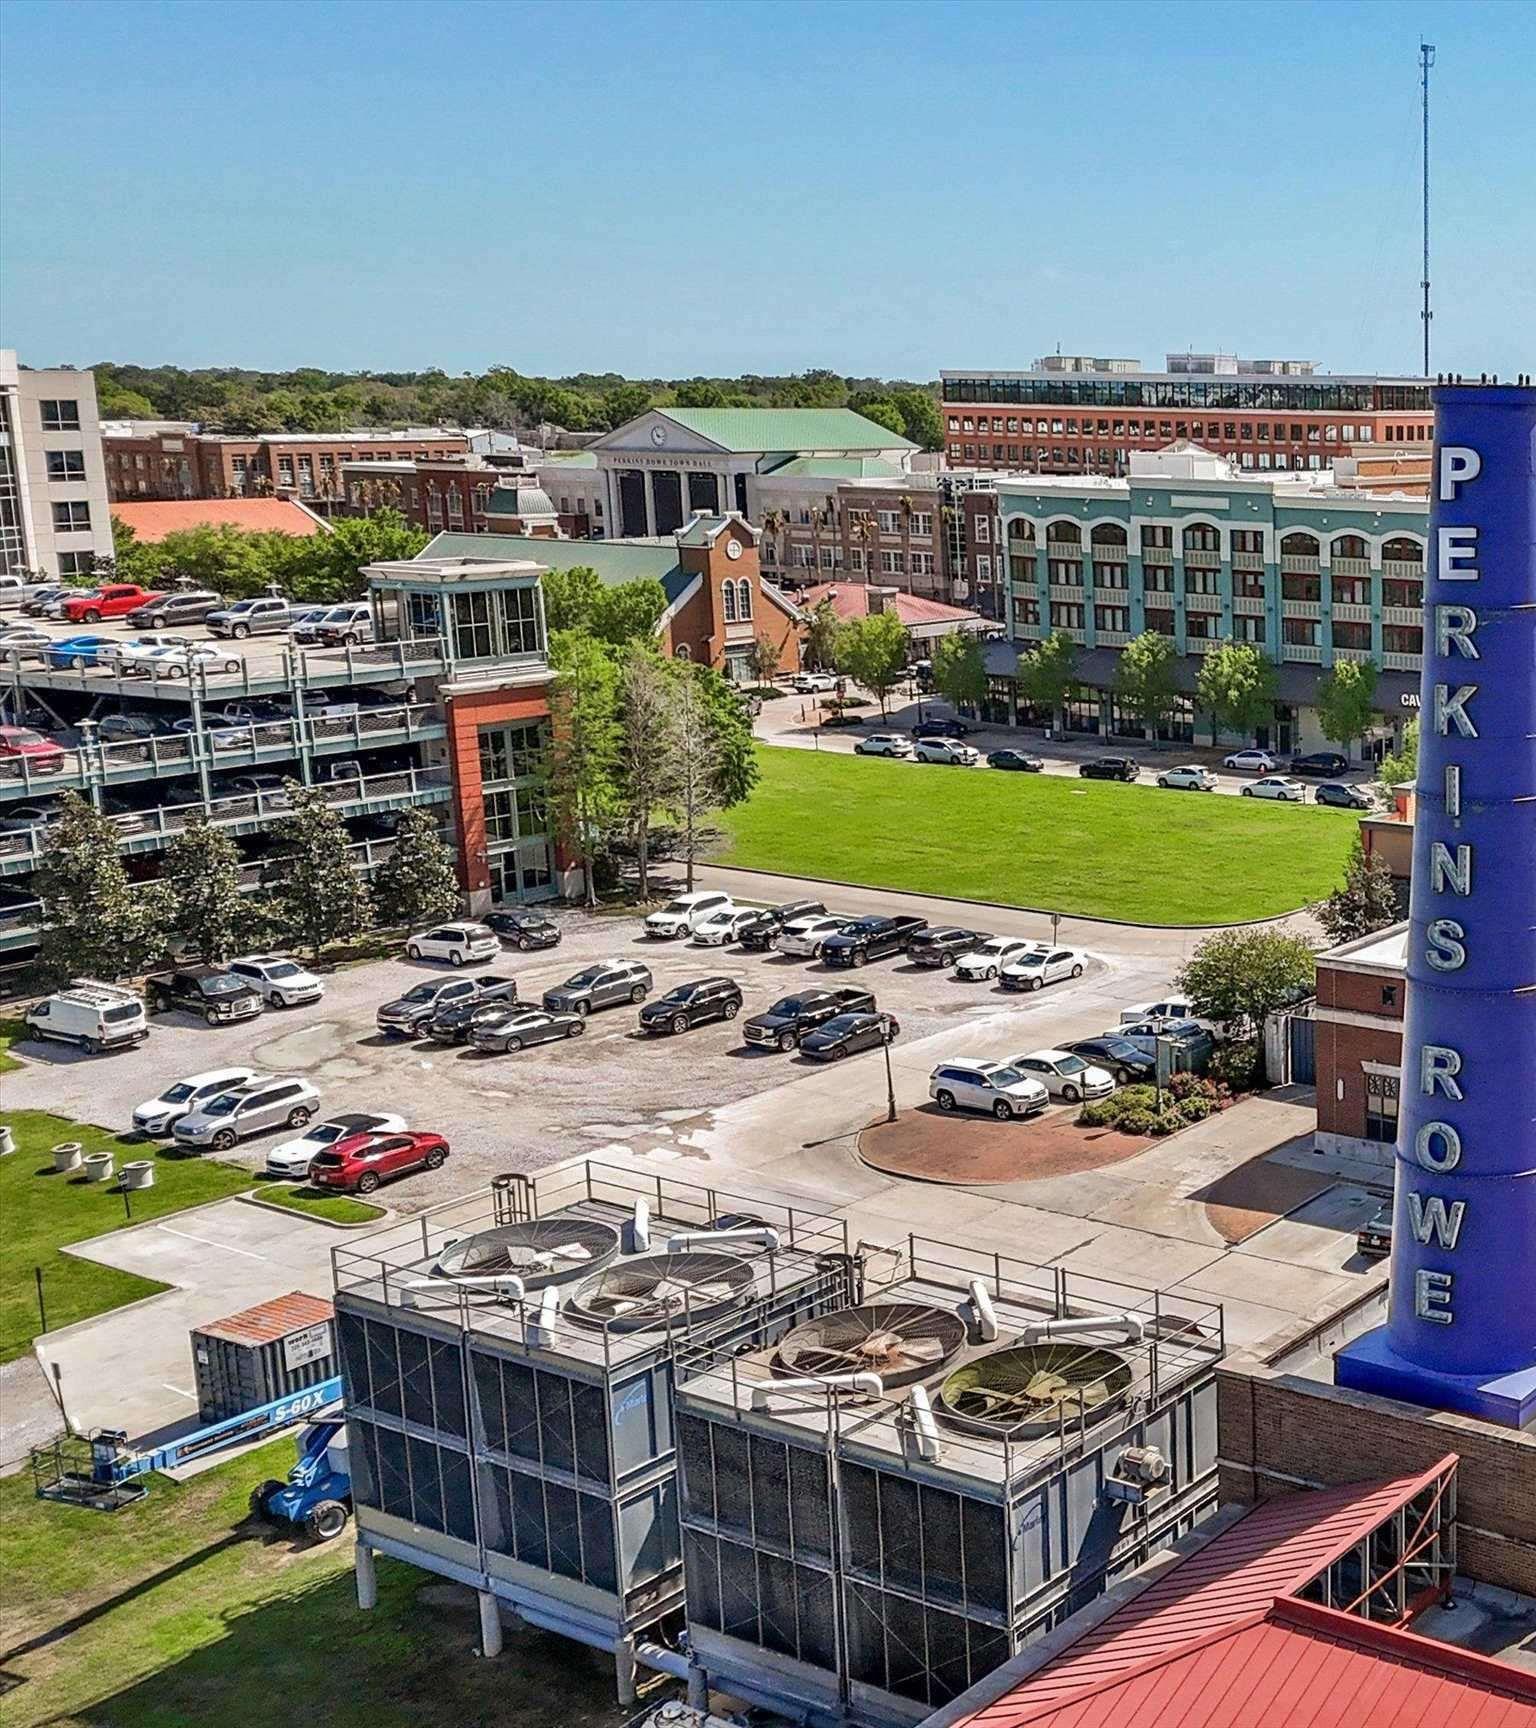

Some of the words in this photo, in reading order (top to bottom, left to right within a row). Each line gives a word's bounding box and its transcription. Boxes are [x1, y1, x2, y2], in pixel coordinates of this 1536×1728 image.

[1401, 693, 1421, 707] CAV
[1425, 446, 1481, 972] PERKINS
[1408, 1044, 1466, 1324] ROWE
